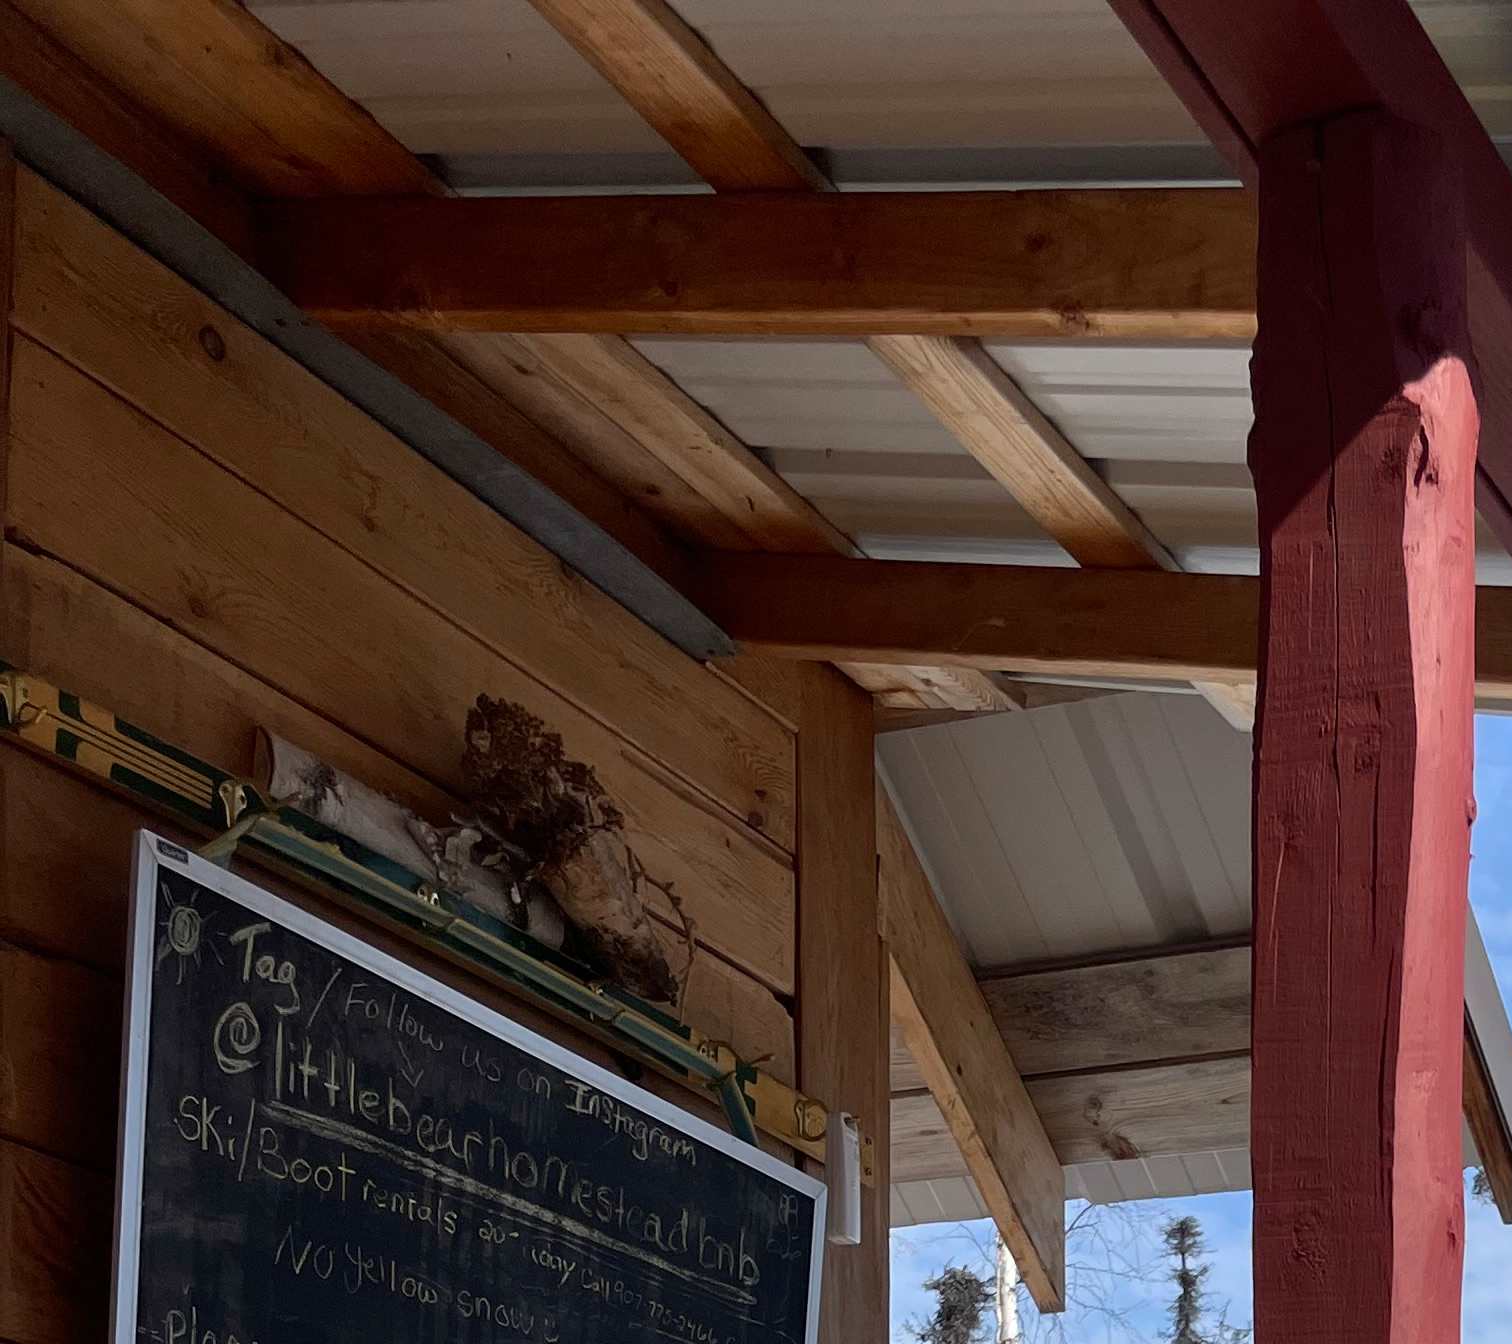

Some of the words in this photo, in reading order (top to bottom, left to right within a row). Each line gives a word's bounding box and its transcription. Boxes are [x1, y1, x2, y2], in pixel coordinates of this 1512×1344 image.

[229, 922, 300, 1015] Tag
[345, 983, 443, 1051] Follow
[462, 1044, 500, 1082] us
[517, 1067, 551, 1099] on
[363, 1179, 458, 1235] rentals
[456, 1289, 535, 1335] snow
